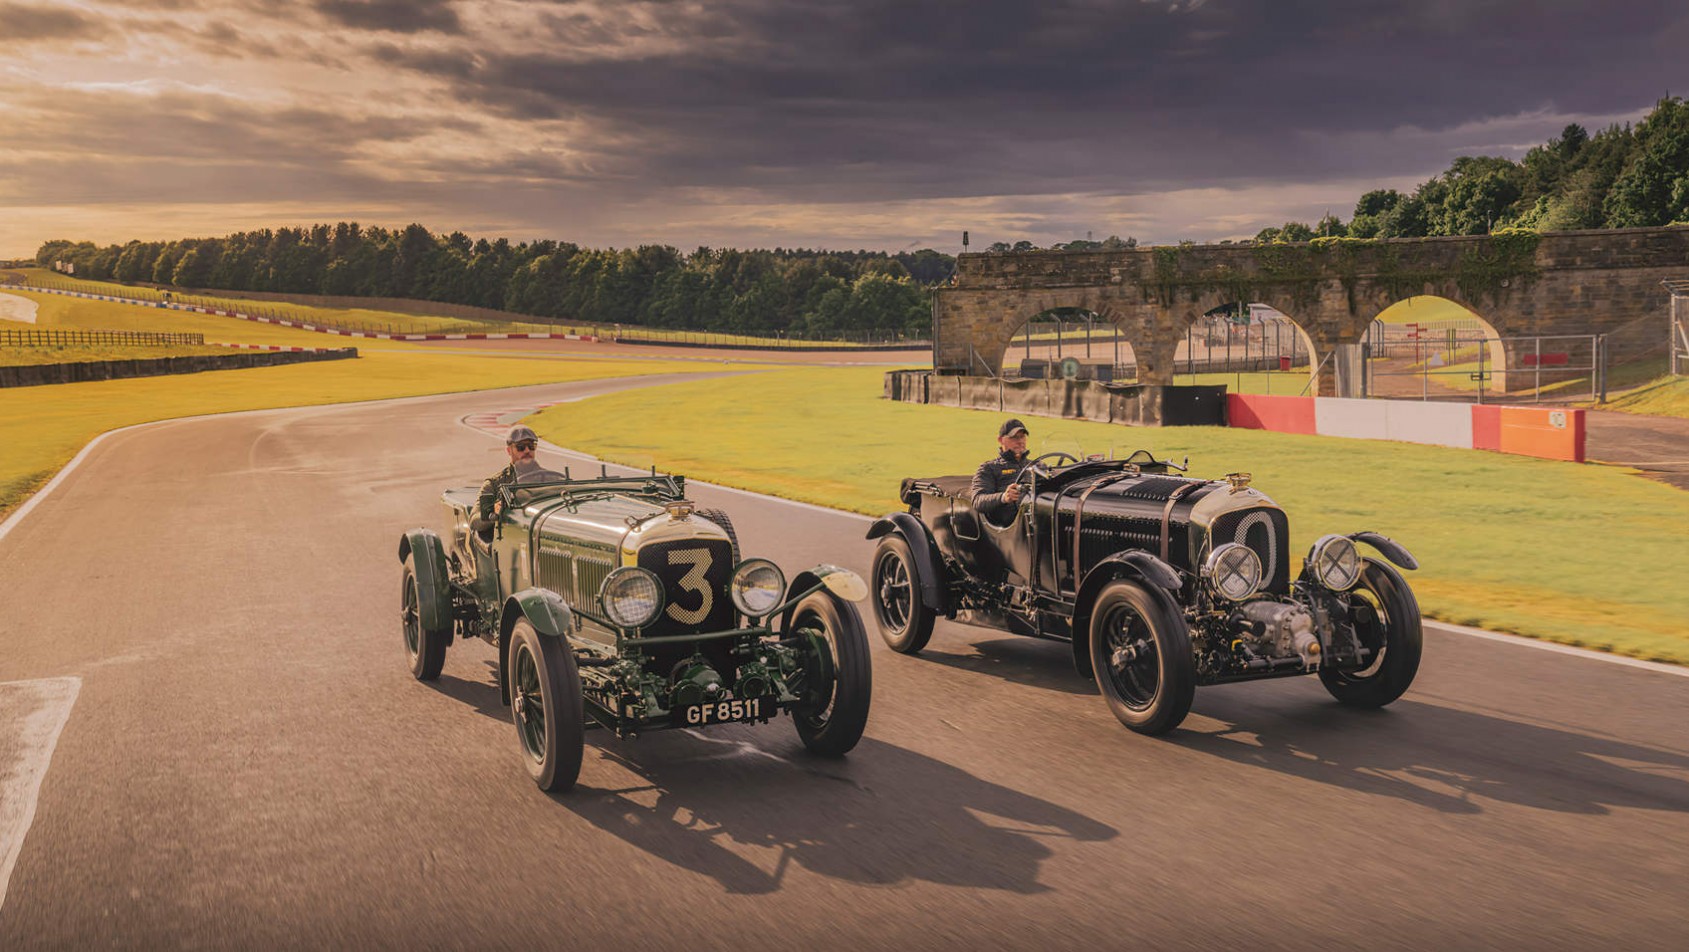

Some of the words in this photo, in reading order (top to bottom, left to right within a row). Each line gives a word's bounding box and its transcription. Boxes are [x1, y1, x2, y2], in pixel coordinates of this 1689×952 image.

[666, 548, 714, 625] 3
[687, 704, 714, 724] GF
[717, 699, 760, 720] 8511
